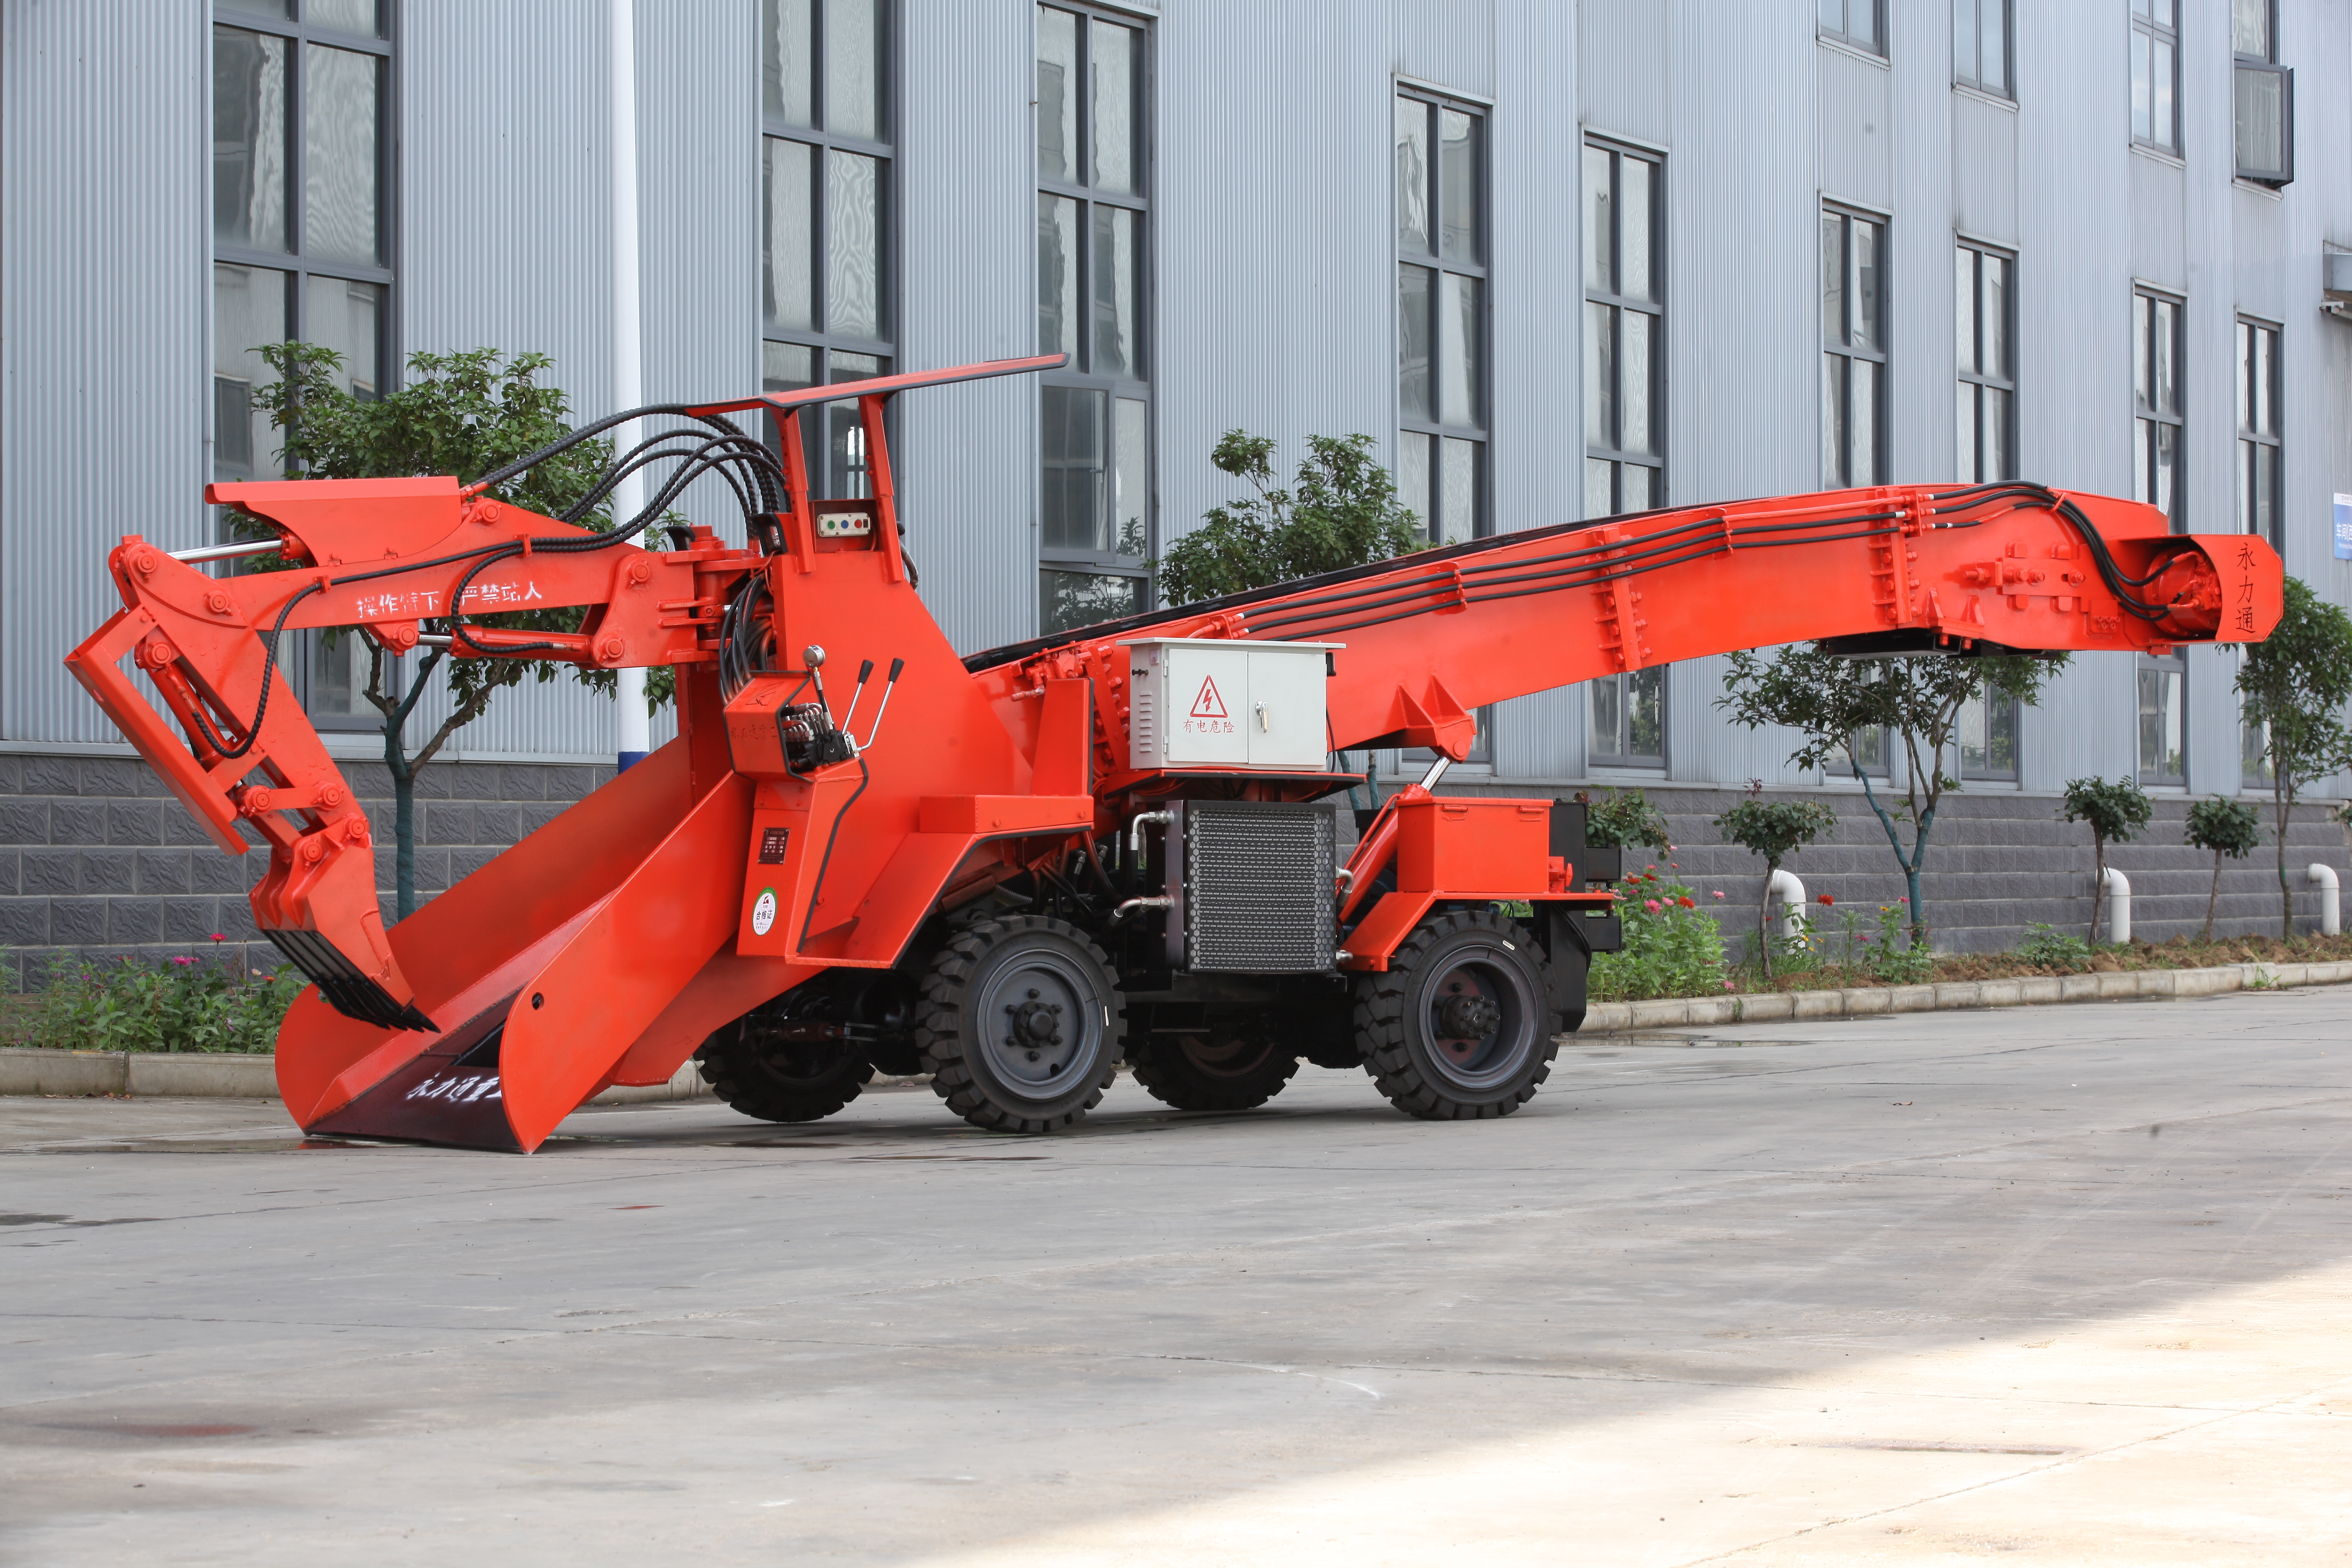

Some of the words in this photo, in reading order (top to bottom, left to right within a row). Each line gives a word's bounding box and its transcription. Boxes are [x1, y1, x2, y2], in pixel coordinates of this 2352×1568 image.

[461, 581, 542, 606] 严禁站人
[2236, 542, 2256, 633] 永力通
[1183, 719, 1235, 733] 有电危险
[756, 910, 772, 920] 合格证
